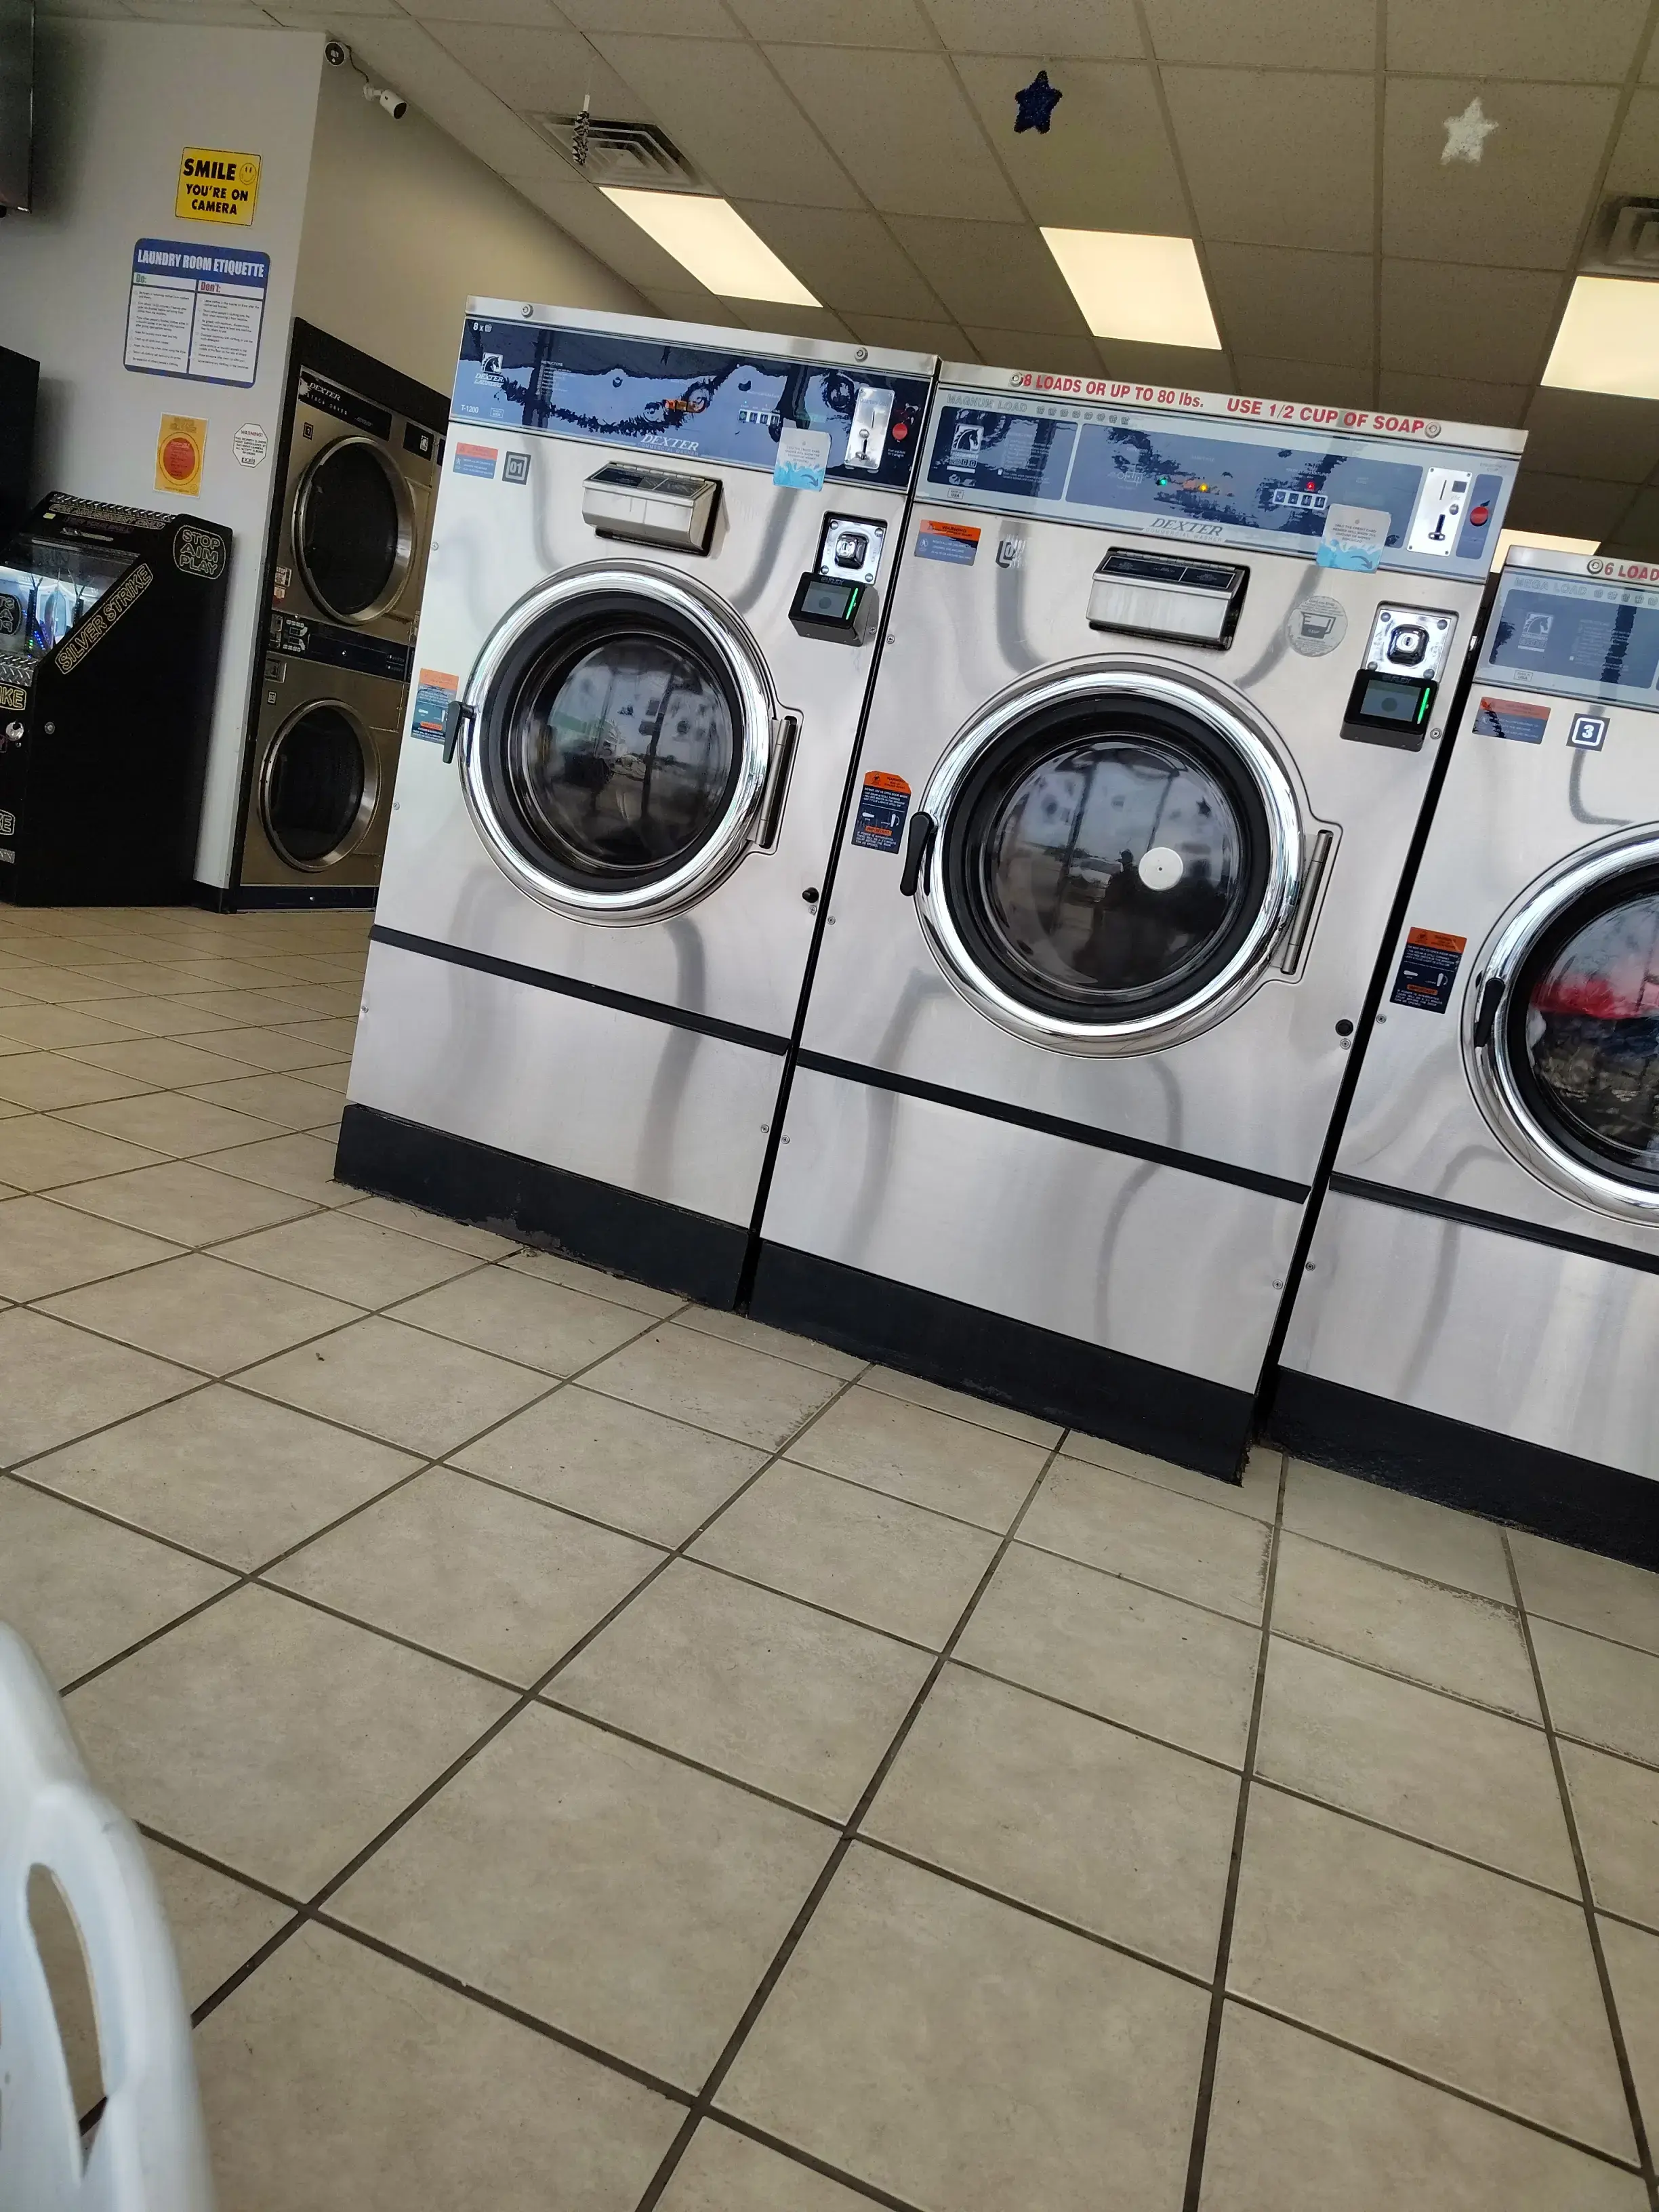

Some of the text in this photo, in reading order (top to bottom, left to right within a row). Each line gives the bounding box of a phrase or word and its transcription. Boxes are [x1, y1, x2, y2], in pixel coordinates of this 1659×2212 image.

[183, 158, 237, 181] SMILE
[186, 184, 248, 201] YOU'RE ON
[191, 199, 237, 215] CAMERA
[138, 249, 265, 278] LAUNDRY ROOM ETIQUETTE
[136, 274, 146, 283] Do:
[201, 282, 221, 293] Don't:
[473, 323, 478, 331] 8
[475, 373, 504, 382] DEXTER
[310, 382, 341, 401] DEXTER
[1036, 375, 1082, 392] LOADS
[1086, 381, 1106, 396] OR
[1110, 385, 1130, 398] UP
[1135, 387, 1153, 401] TO
[1158, 390, 1175, 404] 80
[1179, 392, 1204, 408] lbs.
[461, 405, 478, 413] T-1200
[947, 394, 1027, 412] MAGNUM LOAD
[1227, 398, 1425, 434] USE 1/2 CUP OF SOAP
[638, 443, 672, 452] COMMERCIAL
[640, 434, 699, 451] DEXTER
[510, 462, 522, 474] 01
[1145, 529, 1190, 537] COMMERCIAL
[1149, 518, 1223, 535] DEXTER
[182, 529, 220, 549] STOP
[180, 543, 218, 562] AIM
[180, 554, 218, 575] PLAY
[1605, 562, 1614, 575] 6
[1514, 577, 1587, 596] MEGA LOAD
[58, 565, 151, 670] SILVER STRIKE
[1582, 725, 1594, 738] 3
